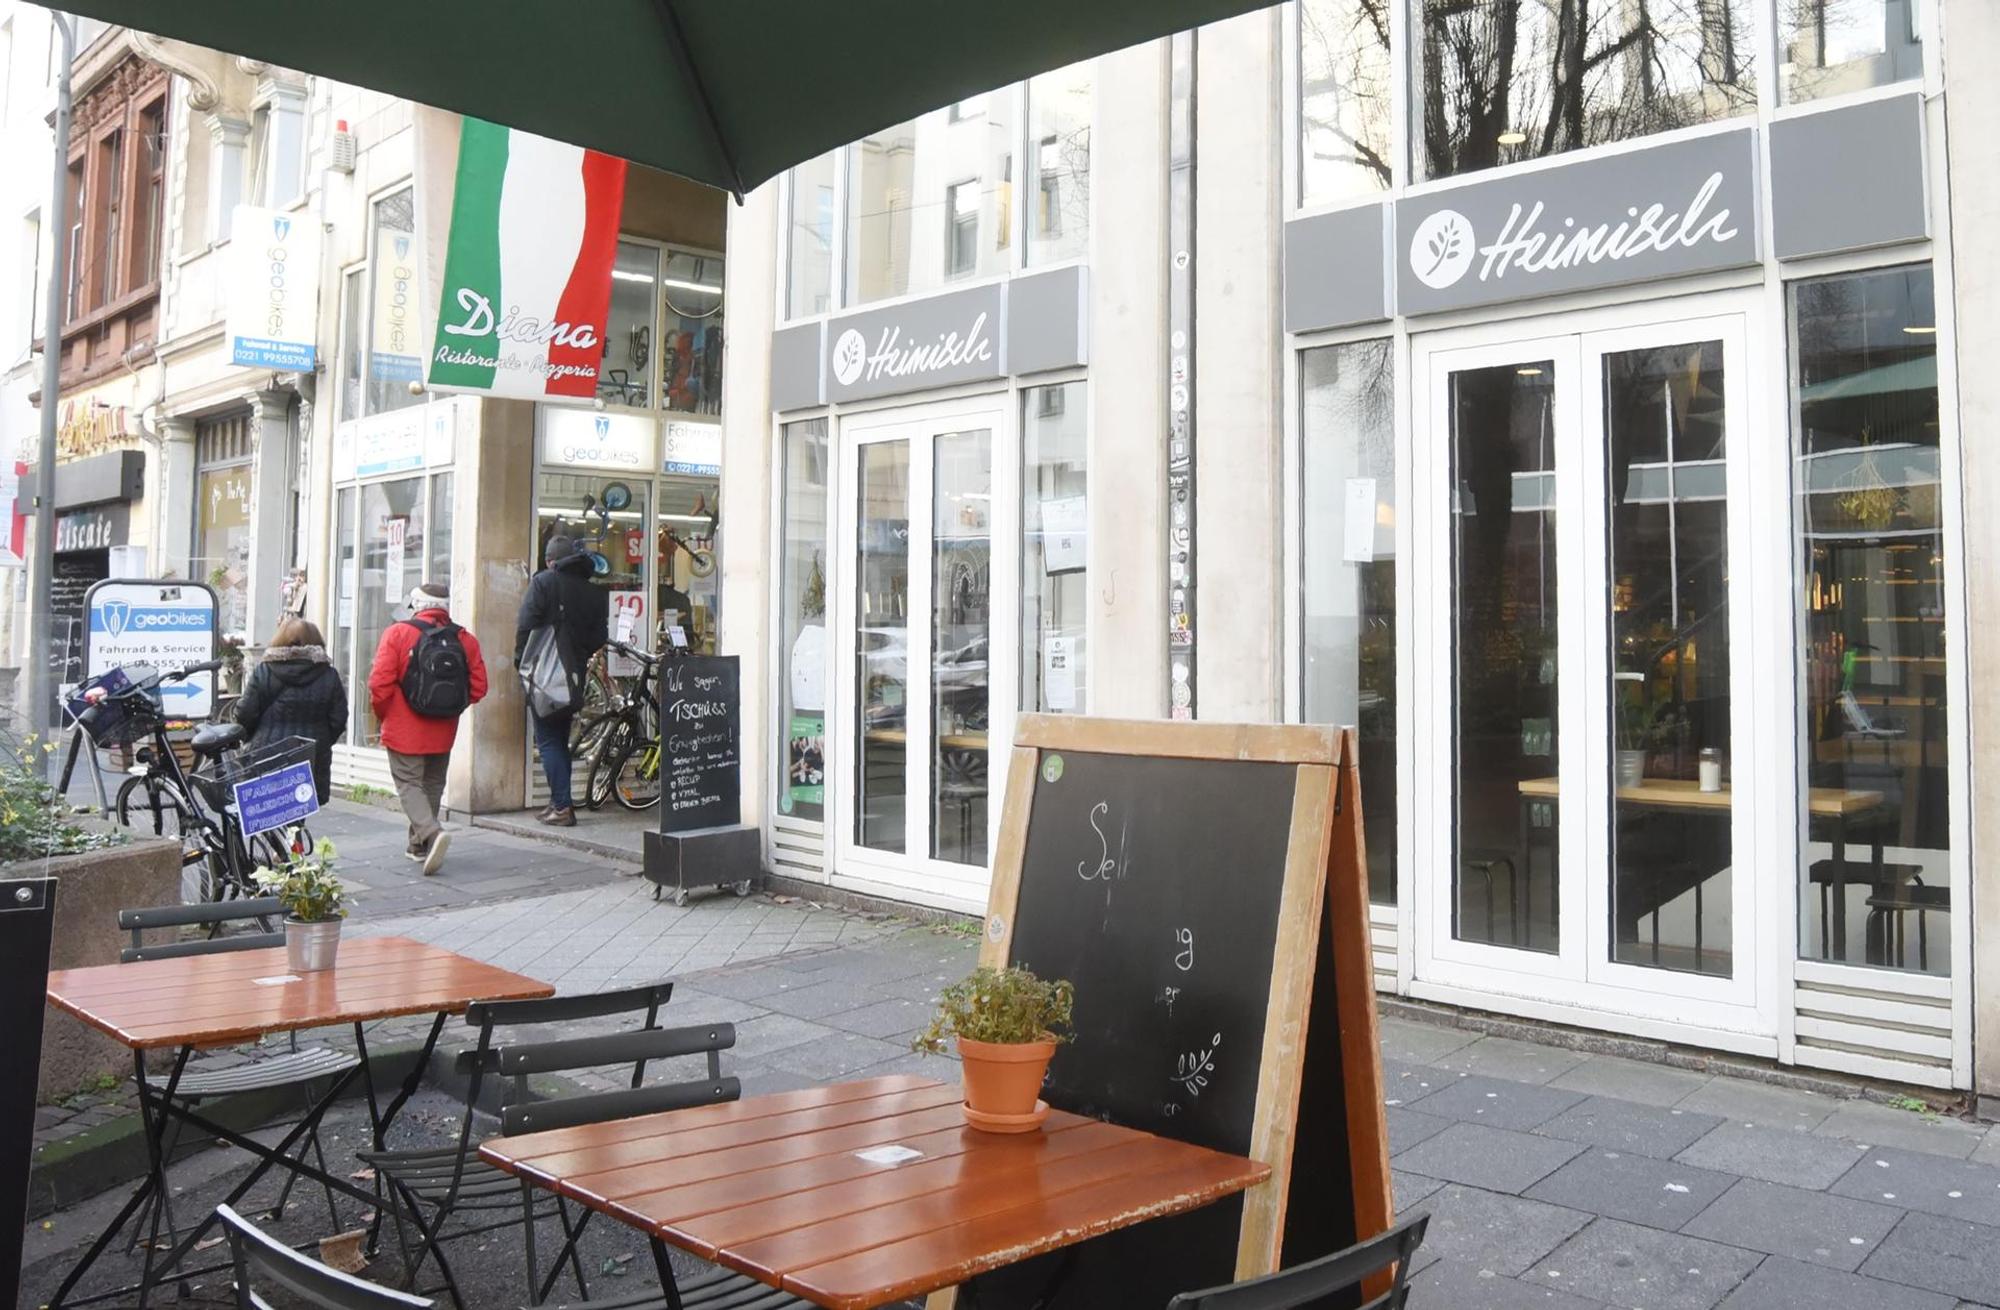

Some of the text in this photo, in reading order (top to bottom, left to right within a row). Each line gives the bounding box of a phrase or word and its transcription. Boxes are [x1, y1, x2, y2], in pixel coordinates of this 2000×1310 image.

[1478, 171, 1739, 283] Heimisch
[267, 247, 288, 337] geobikes
[444, 287, 598, 349] Diana
[235, 349, 259, 361] 0221
[435, 345, 522, 370] Ristorante
[528, 353, 597, 381] Pizzeria
[866, 311, 993, 383] Heimisch
[563, 445, 639, 465] geobikes
[135, 611, 206, 628] geobikes
[99, 645, 206, 654] Fahrrad & Service
